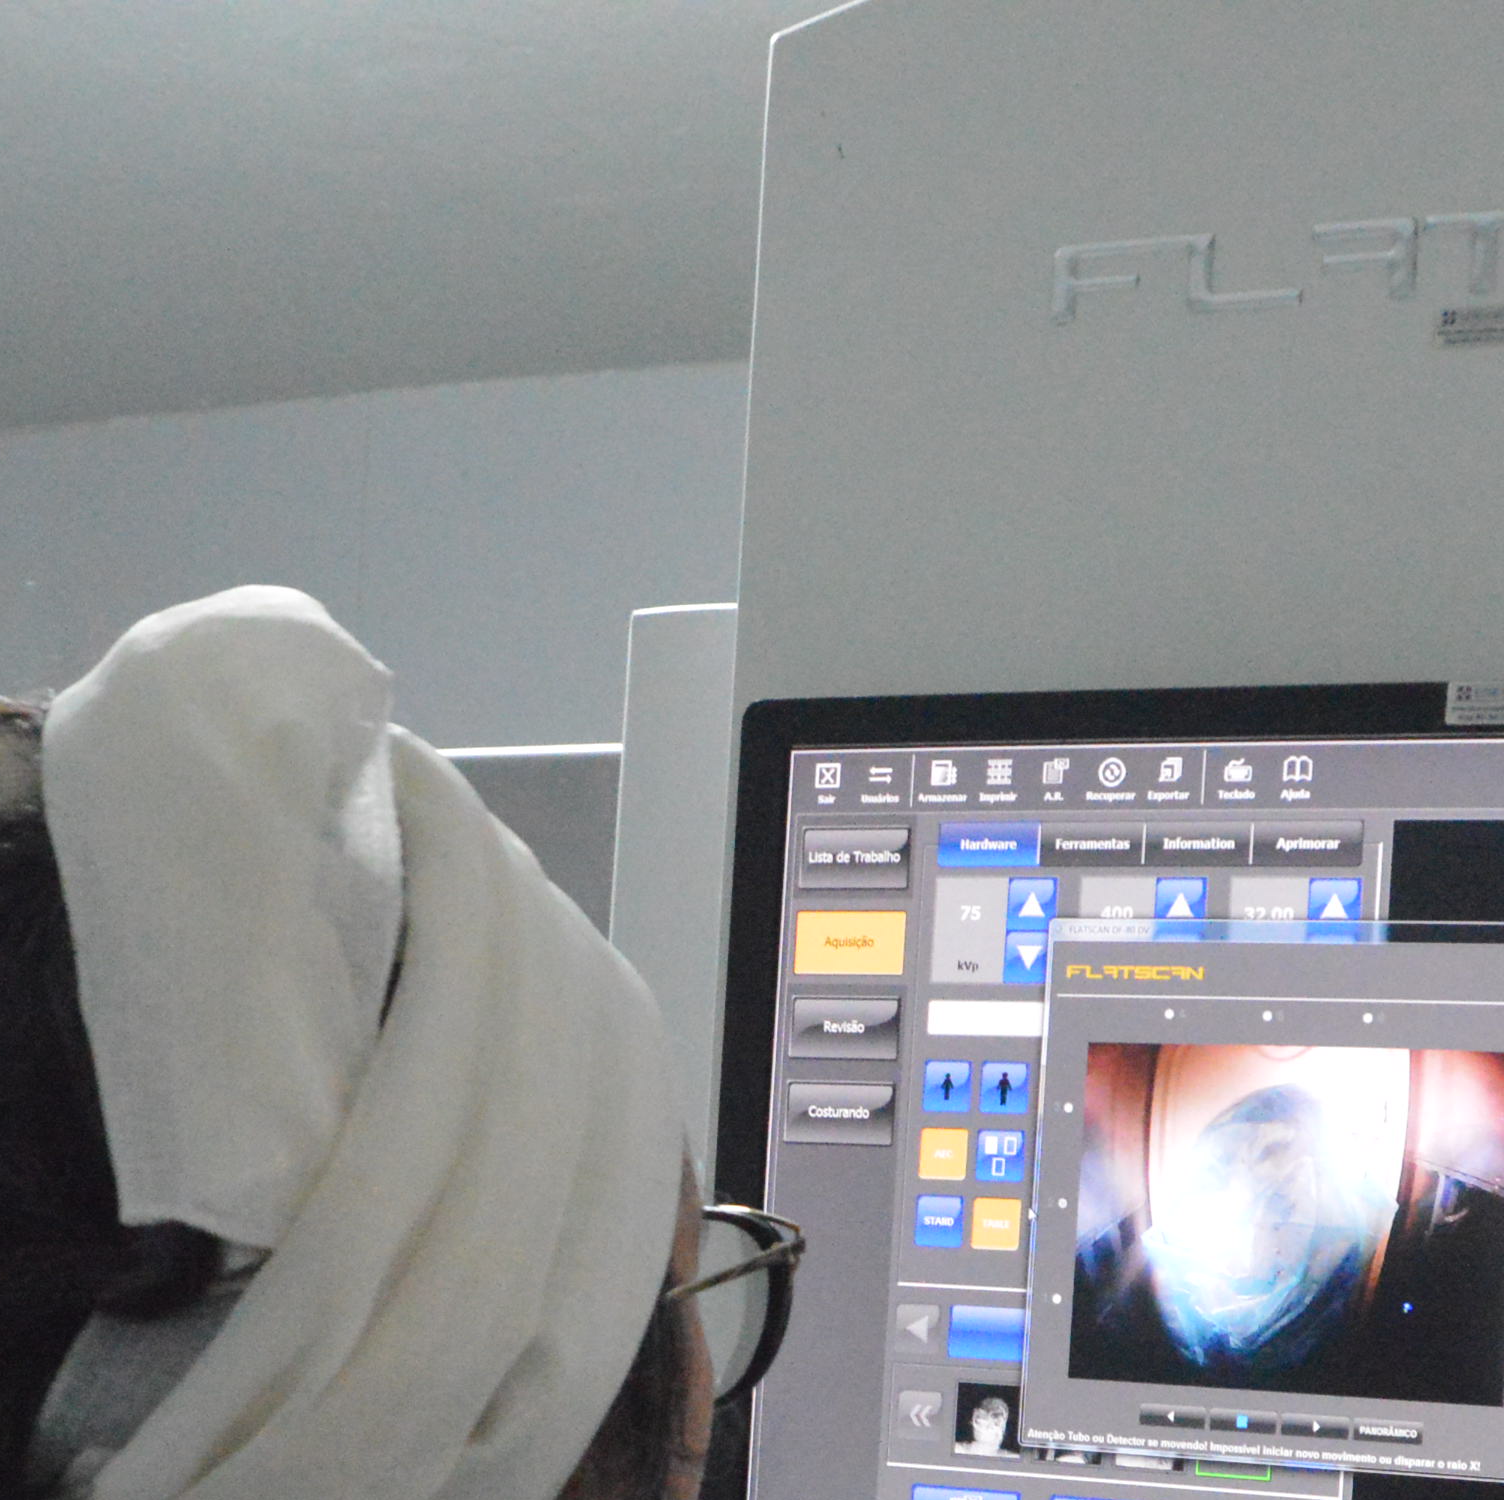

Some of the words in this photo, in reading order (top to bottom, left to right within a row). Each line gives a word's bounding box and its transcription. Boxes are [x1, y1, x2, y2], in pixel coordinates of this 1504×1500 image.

[918, 793, 968, 803] Armazenar
[979, 792, 1018, 804] Imprimir
[1086, 791, 1136, 803] Recuperar
[1147, 790, 1190, 802] Exportar
[1218, 789, 1256, 800] Teclado
[1280, 788, 1311, 802] Ajuda
[960, 838, 1017, 851] Hardware
[1055, 837, 1130, 851] Ferramentas
[1163, 837, 1235, 850] Information
[1276, 837, 1341, 852] Aprimorar
[809, 851, 834, 864] Lista
[836, 850, 851, 864] de
[853, 849, 901, 864] Trabalho
[960, 905, 982, 921] 75
[1100, 905, 1134, 918] 400
[1244, 906, 1295, 920] 32.00
[824, 936, 874, 950] Aquisição
[957, 960, 979, 973] kVp
[1066, 964, 1205, 981] FLATSCAN
[823, 1019, 865, 1034] Revisão
[808, 1105, 870, 1120] Costurando
[1027, 1428, 1065, 1442] Atenção
[1068, 1430, 1090, 1442] Tubo
[1092, 1434, 1105, 1444] ou
[1107, 1433, 1146, 1447] Detector
[1147, 1438, 1159, 1449] se
[1161, 1439, 1208, 1451] movendo!
[1296, 1450, 1320, 1460] novo
[1322, 1450, 1377, 1464] movimento
[1379, 1455, 1392, 1465] ou
[1394, 1455, 1435, 1469] disparar
[1437, 1459, 1445, 1469] o
[1447, 1459, 1468, 1471] raio
